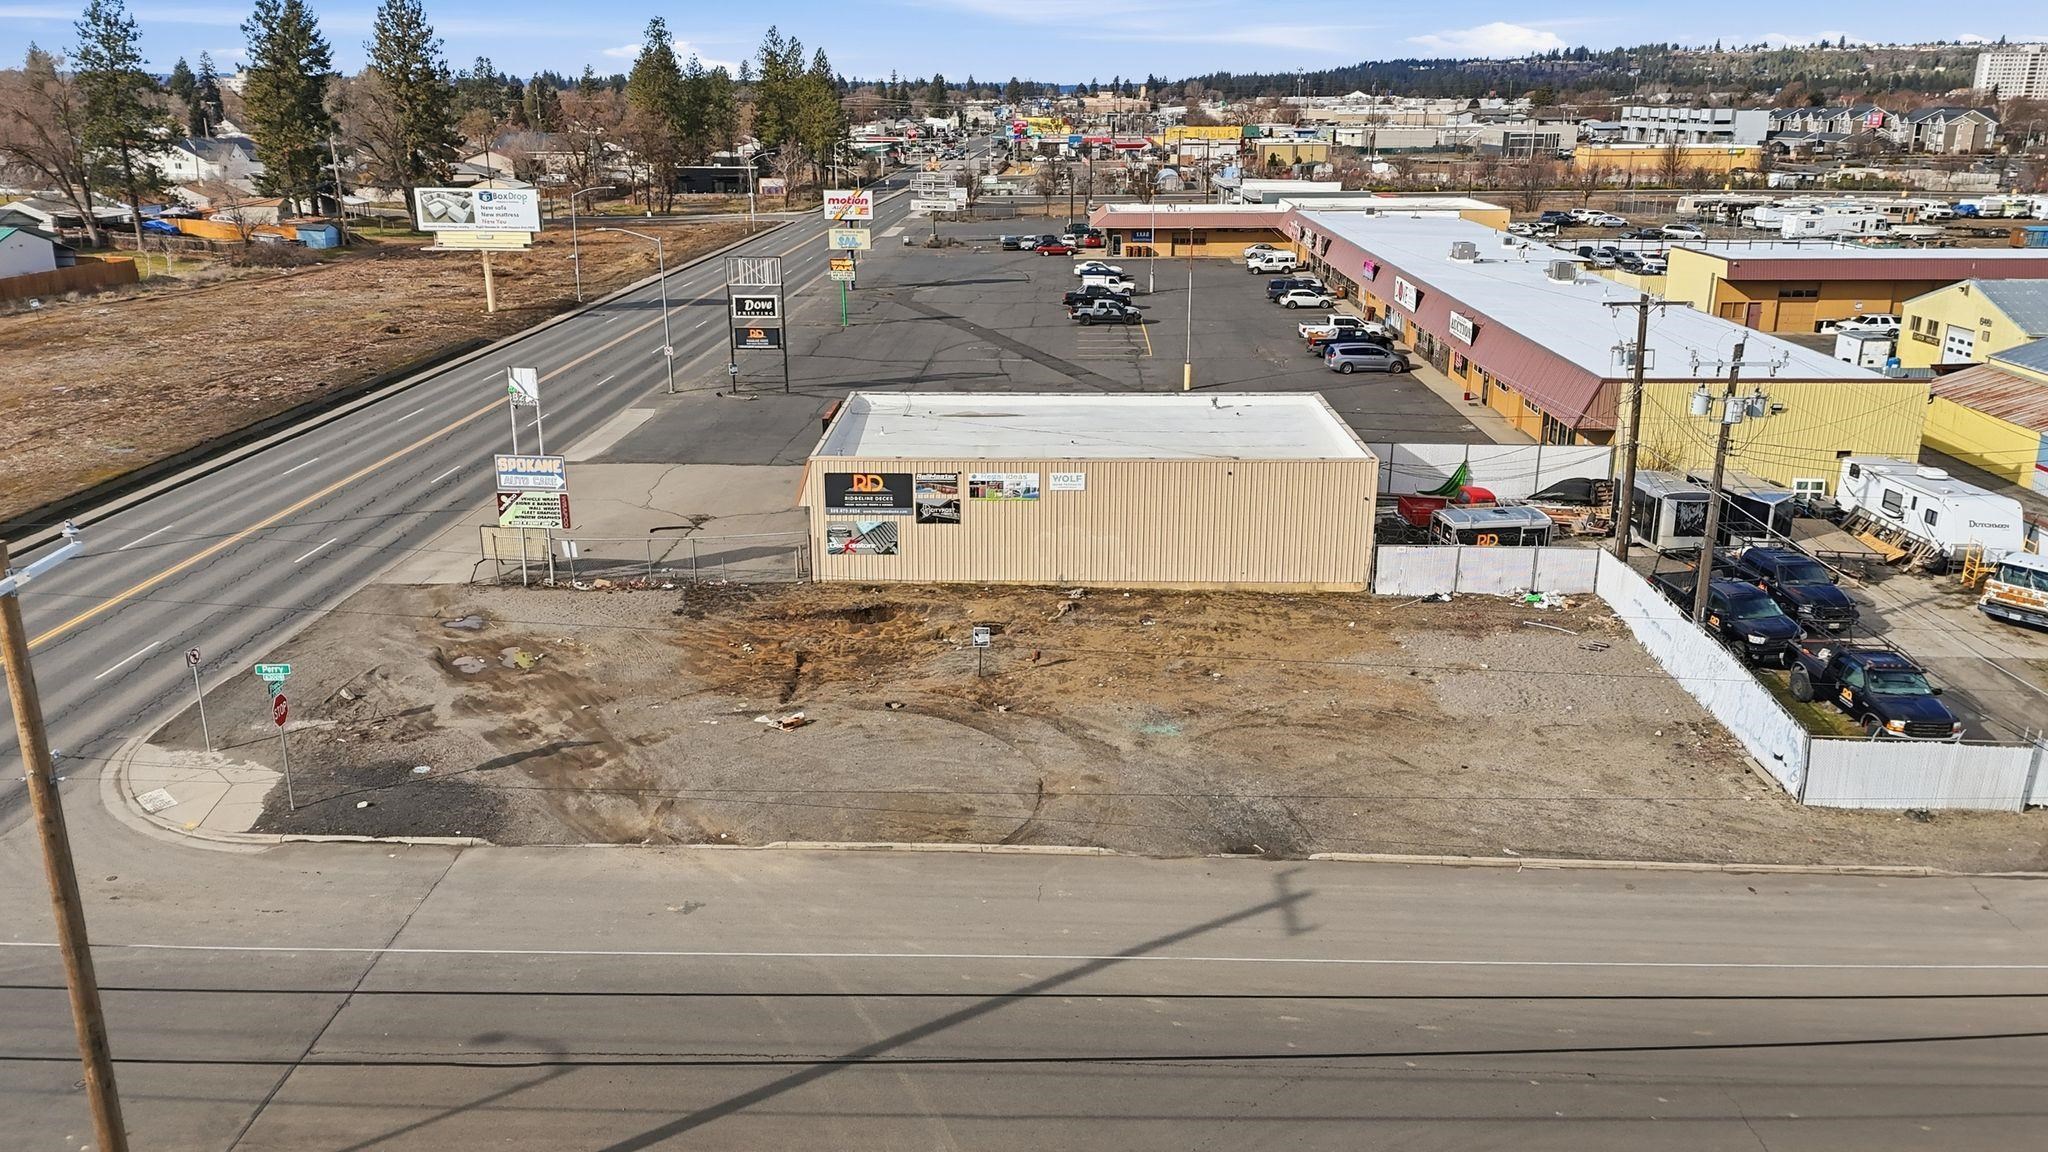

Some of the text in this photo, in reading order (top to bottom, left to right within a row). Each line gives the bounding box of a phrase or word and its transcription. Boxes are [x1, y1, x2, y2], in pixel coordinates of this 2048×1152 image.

[493, 192, 528, 205] BoxDrop
[828, 195, 868, 205] motion
[744, 299, 773, 311] Dove
[497, 457, 562, 473] SPOKANE
[503, 475, 530, 486] AUTO
[853, 474, 884, 492] RD
[1052, 474, 1083, 482] WOLF
[262, 665, 284, 674] Perry
[274, 701, 286, 720] STOP
